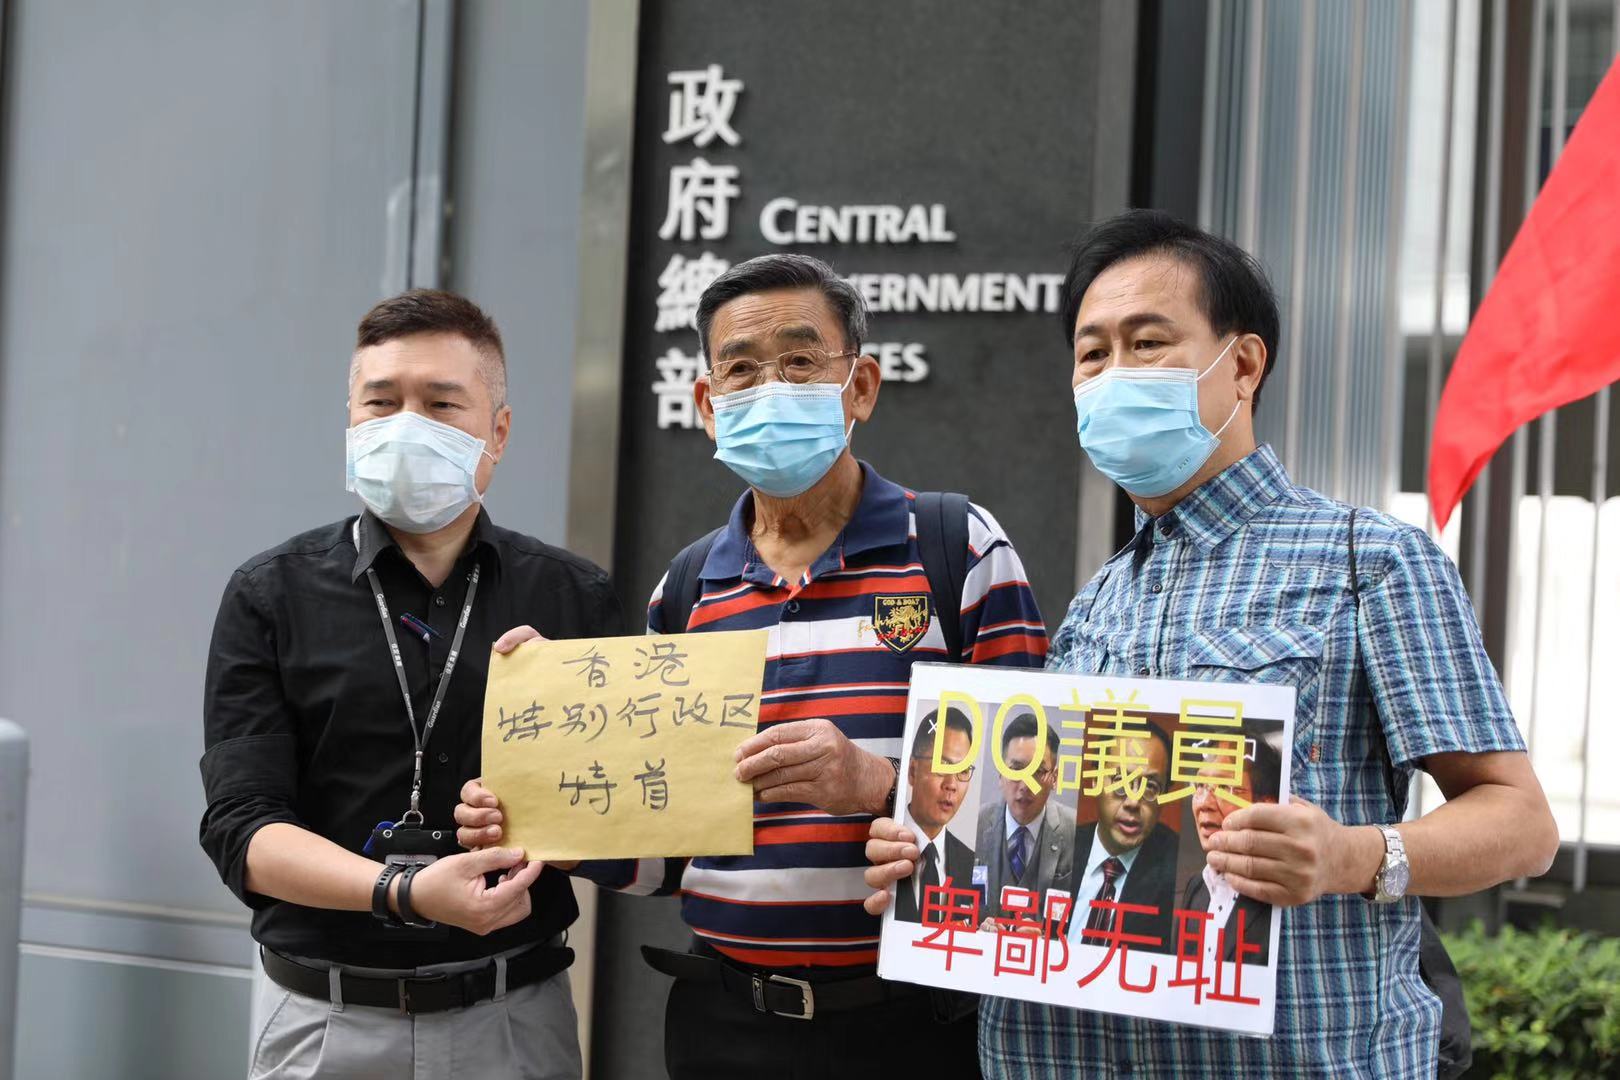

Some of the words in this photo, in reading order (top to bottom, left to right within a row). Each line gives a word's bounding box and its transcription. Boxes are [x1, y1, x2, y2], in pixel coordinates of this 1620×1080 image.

[759, 197, 956, 244] CENTRAL
[563, 642, 690, 688] 香港
[427, 701, 441, 729] Guardian
[497, 692, 757, 743] 特别行政区
[930, 687, 1251, 809] DQ議員
[559, 758, 669, 815] 特首
[912, 876, 1261, 1006] 卑鄙无耻
